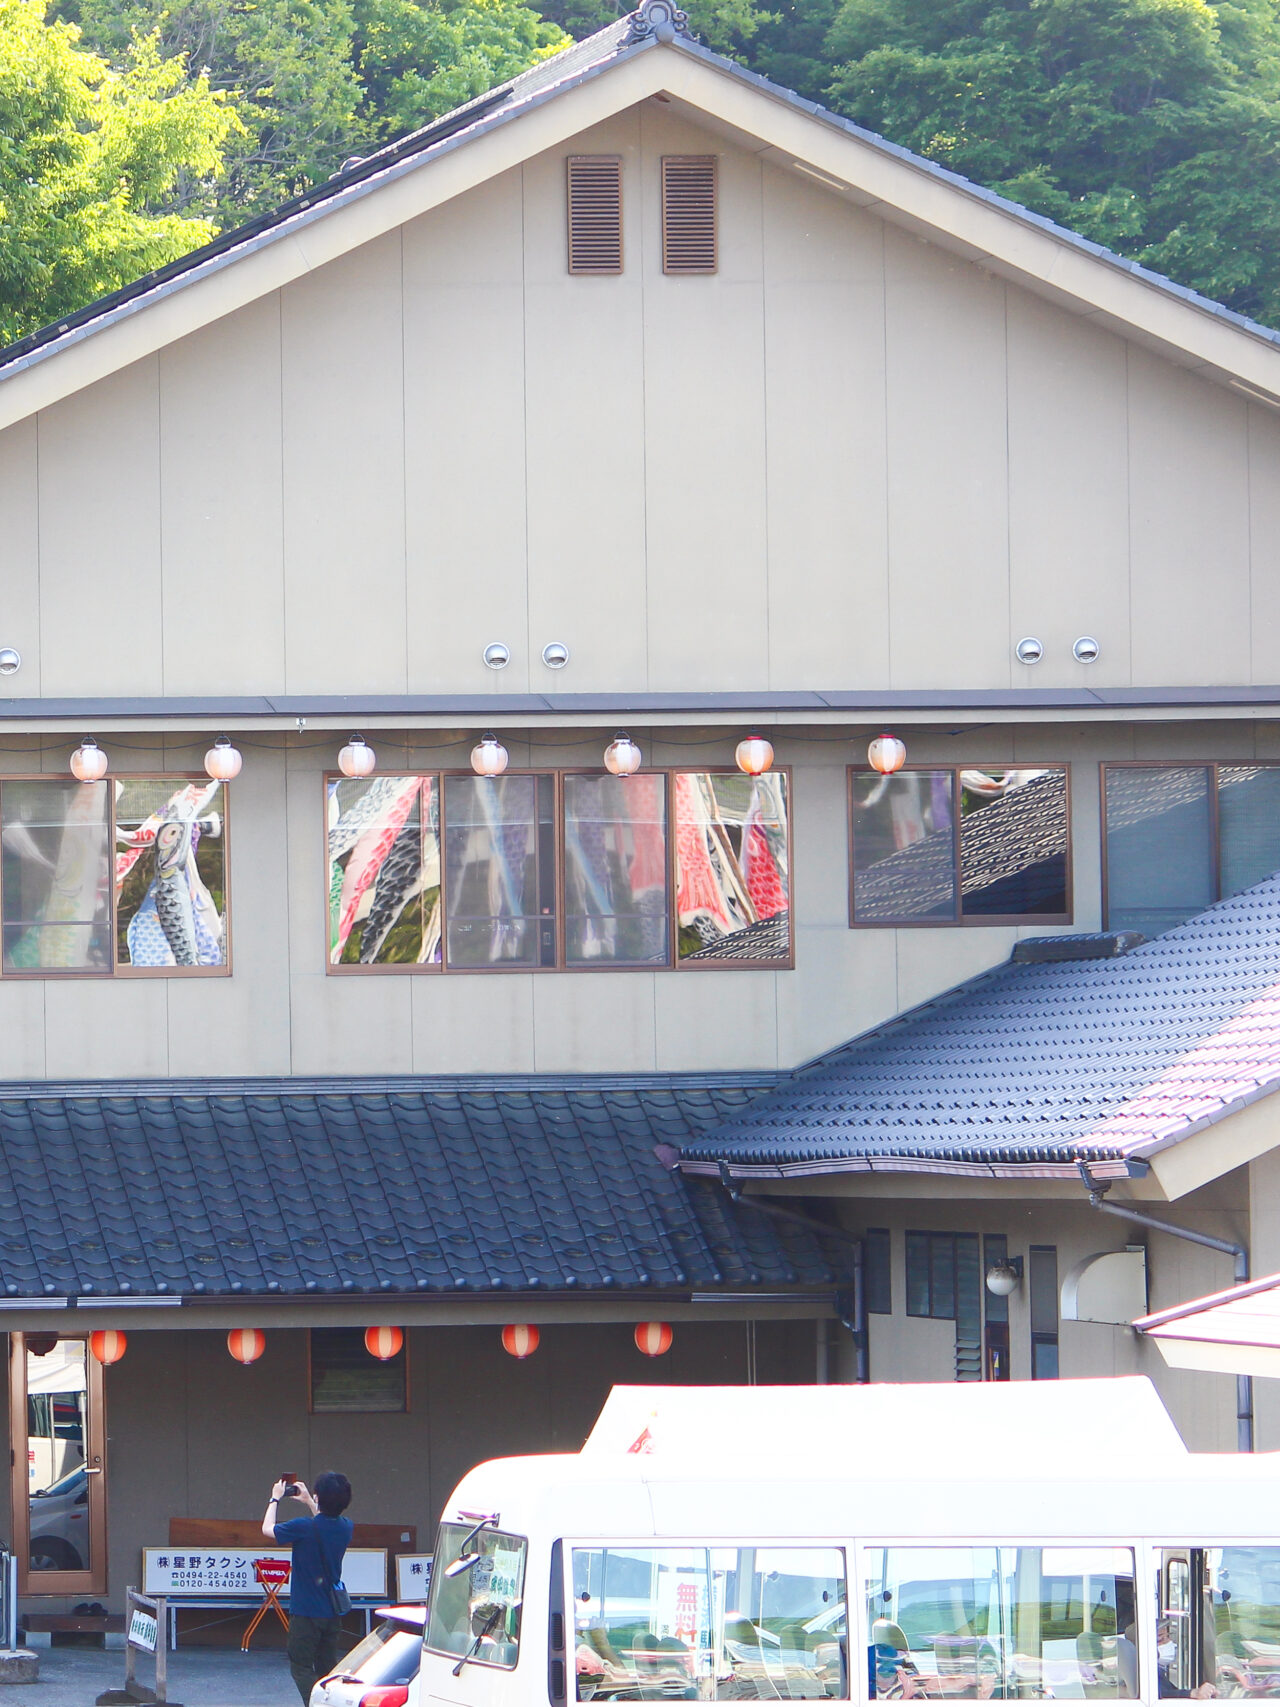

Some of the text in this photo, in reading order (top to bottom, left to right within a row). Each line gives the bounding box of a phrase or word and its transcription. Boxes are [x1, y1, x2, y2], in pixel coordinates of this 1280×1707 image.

[156, 1555, 248, 1569] ㈱星野タクシ
[179, 1571, 248, 1579] 0494-22-4540
[179, 1580, 248, 1588] 0120-454022
